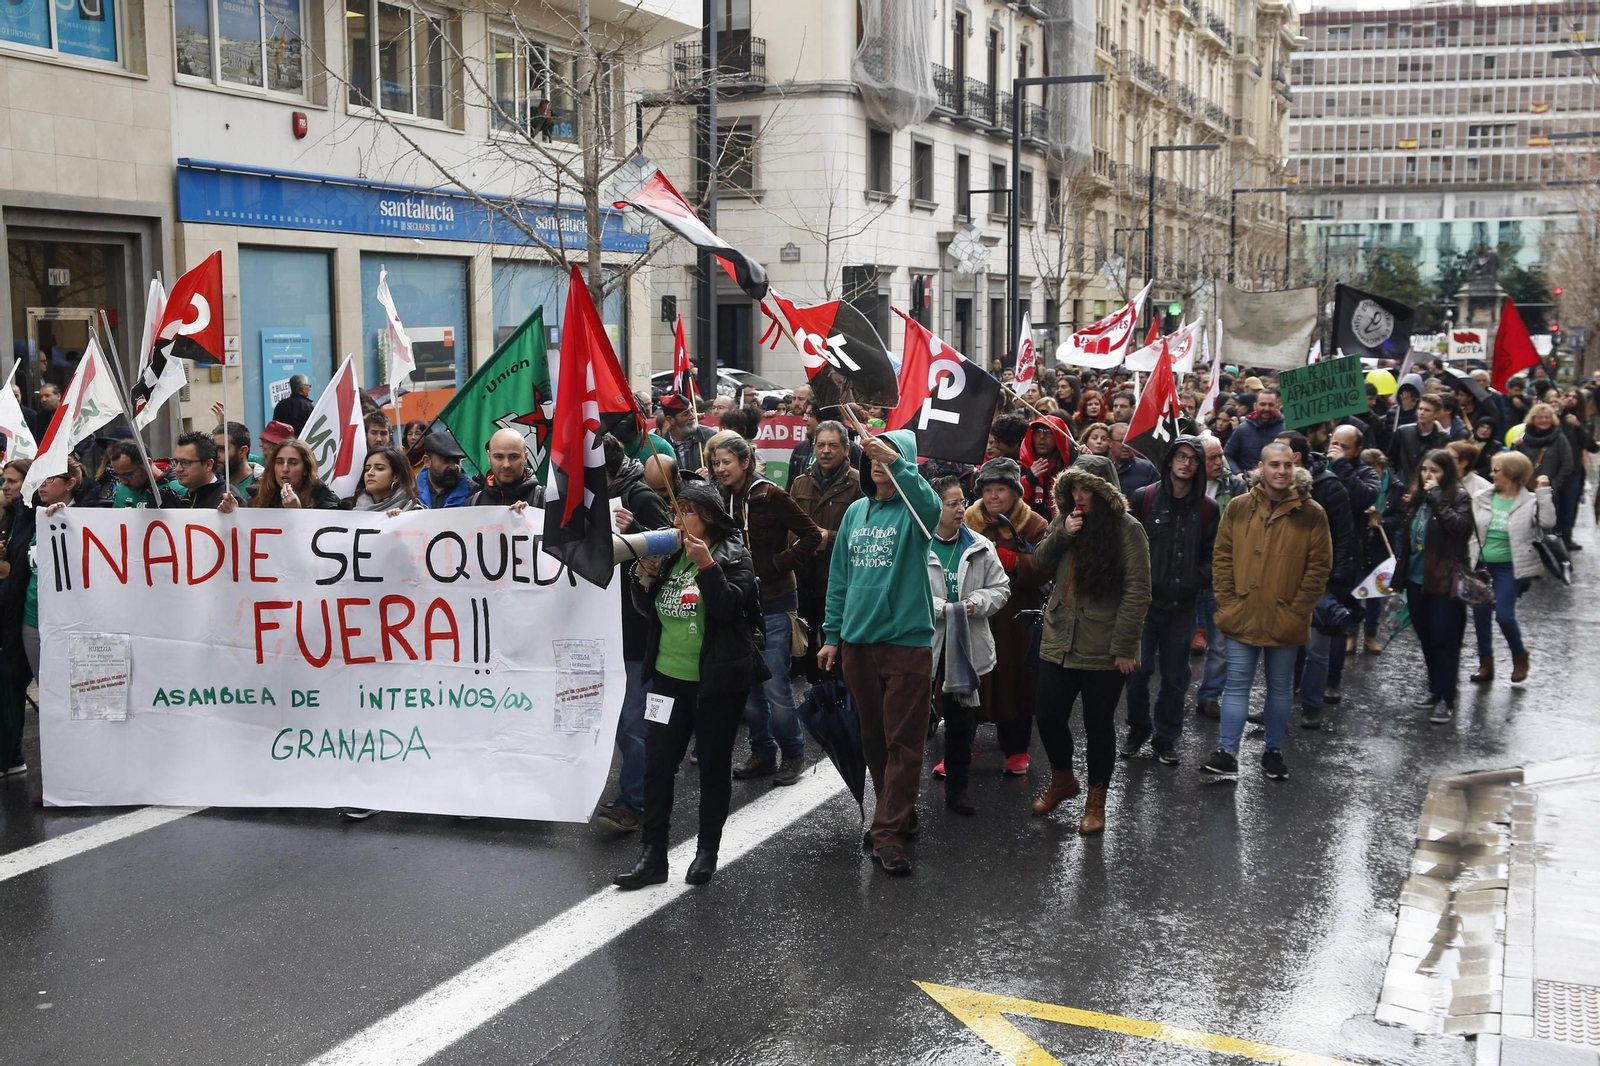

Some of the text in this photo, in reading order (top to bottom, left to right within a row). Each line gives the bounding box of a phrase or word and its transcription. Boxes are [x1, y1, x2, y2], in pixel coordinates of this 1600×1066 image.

[380, 198, 454, 221] santalucía
[535, 213, 588, 233] sanalucía
[50, 269, 69, 285] 10
[795, 327, 862, 372] CGT
[1456, 345, 1484, 354] USTEA
[485, 359, 531, 394] Unión
[1286, 374, 1357, 403] APADRINA UN
[1291, 389, 1360, 421] INTERIN@
[311, 525, 384, 586] SE
[425, 530, 577, 588] QUED
[682, 602, 697, 610] CGT
[152, 686, 277, 708] ASAMBLEA
[291, 689, 321, 708] DE
[270, 725, 433, 764] GRANADA
